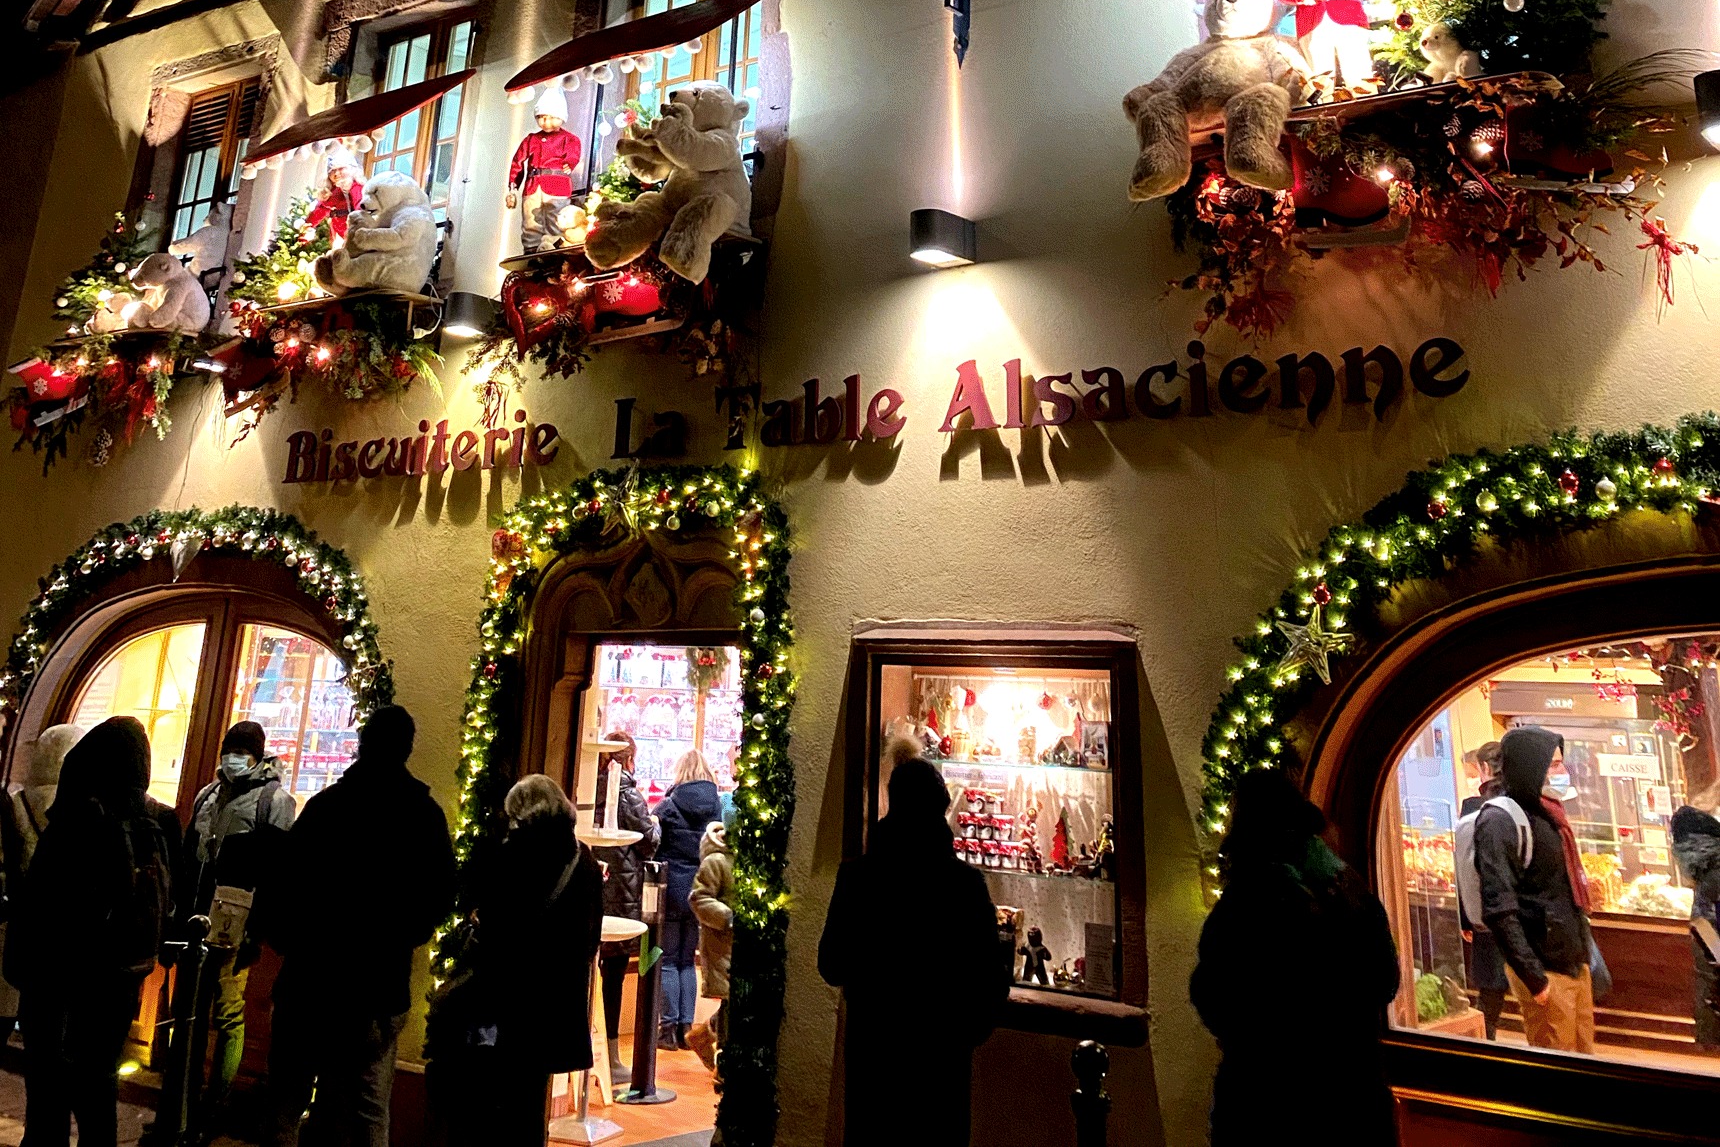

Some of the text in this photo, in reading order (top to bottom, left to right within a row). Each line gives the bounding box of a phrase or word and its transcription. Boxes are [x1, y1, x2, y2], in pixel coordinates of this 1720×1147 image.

[282, 337, 1471, 484] Biscuiterie La Table Alsacienne
[1611, 762, 1648, 774] CAISSE
